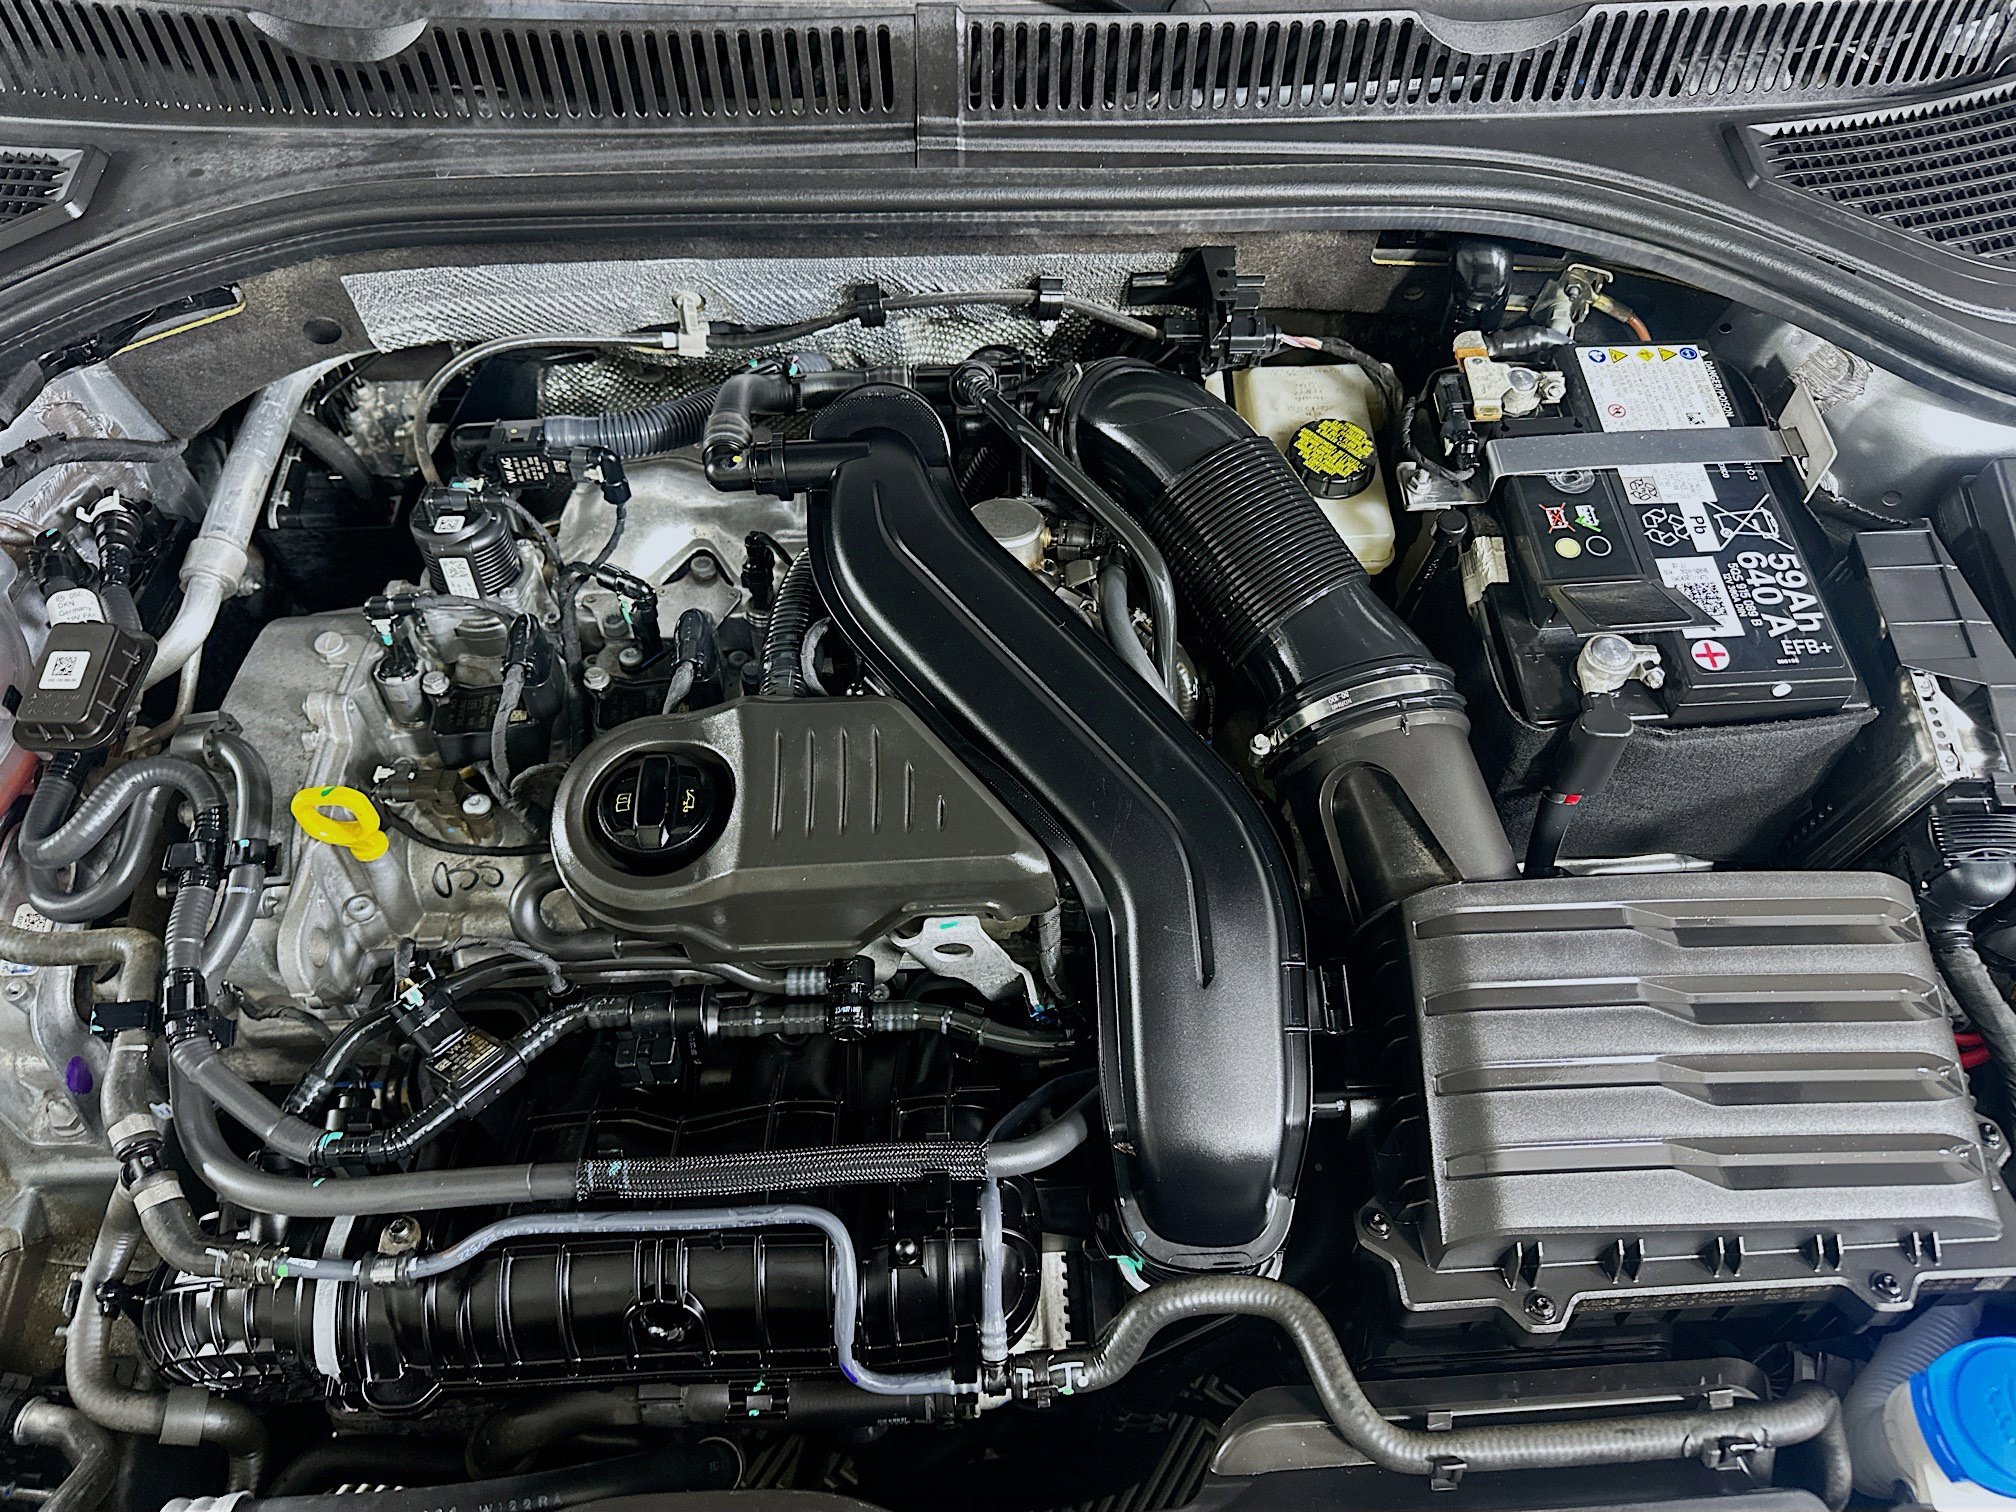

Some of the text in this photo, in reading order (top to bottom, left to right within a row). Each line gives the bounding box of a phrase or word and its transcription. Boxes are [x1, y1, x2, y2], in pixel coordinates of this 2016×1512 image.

[1690, 516, 1707, 534] Pb
[1736, 583, 1751, 598] 915
[1751, 618, 1763, 627] B
[1737, 551, 1783, 605] 640
[1761, 613, 1798, 638] A
[1768, 553, 1825, 632] 59Ah
[59, 607, 92, 616] Germany
[1781, 639, 1833, 655] EFB+
